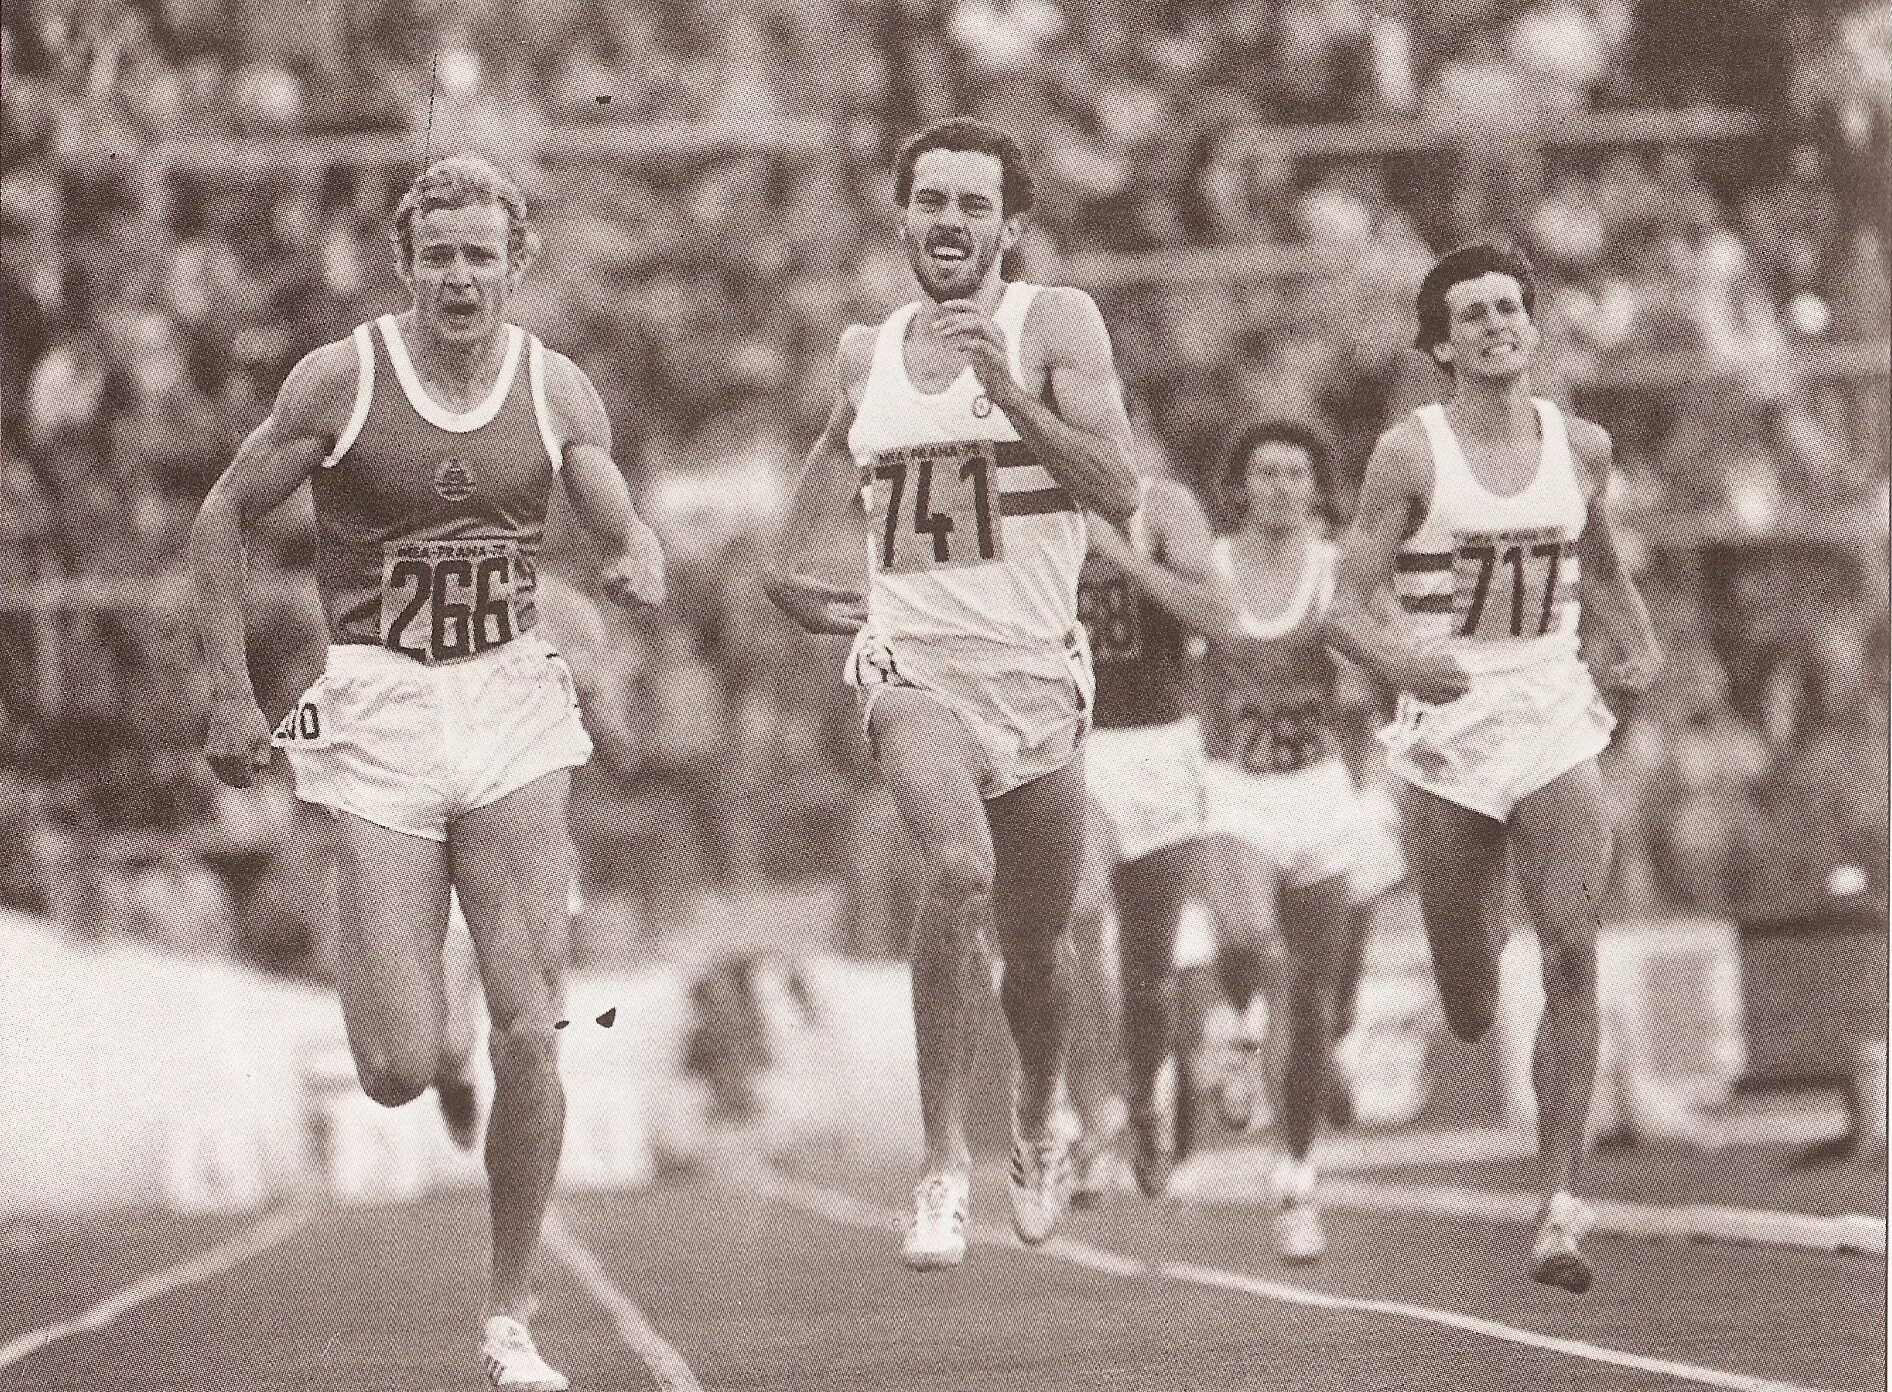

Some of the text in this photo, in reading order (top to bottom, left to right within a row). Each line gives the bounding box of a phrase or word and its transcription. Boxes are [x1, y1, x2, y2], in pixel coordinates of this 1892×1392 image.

[875, 456, 995, 567] 741
[386, 556, 513, 662] 266
[1459, 542, 1561, 636] 717
